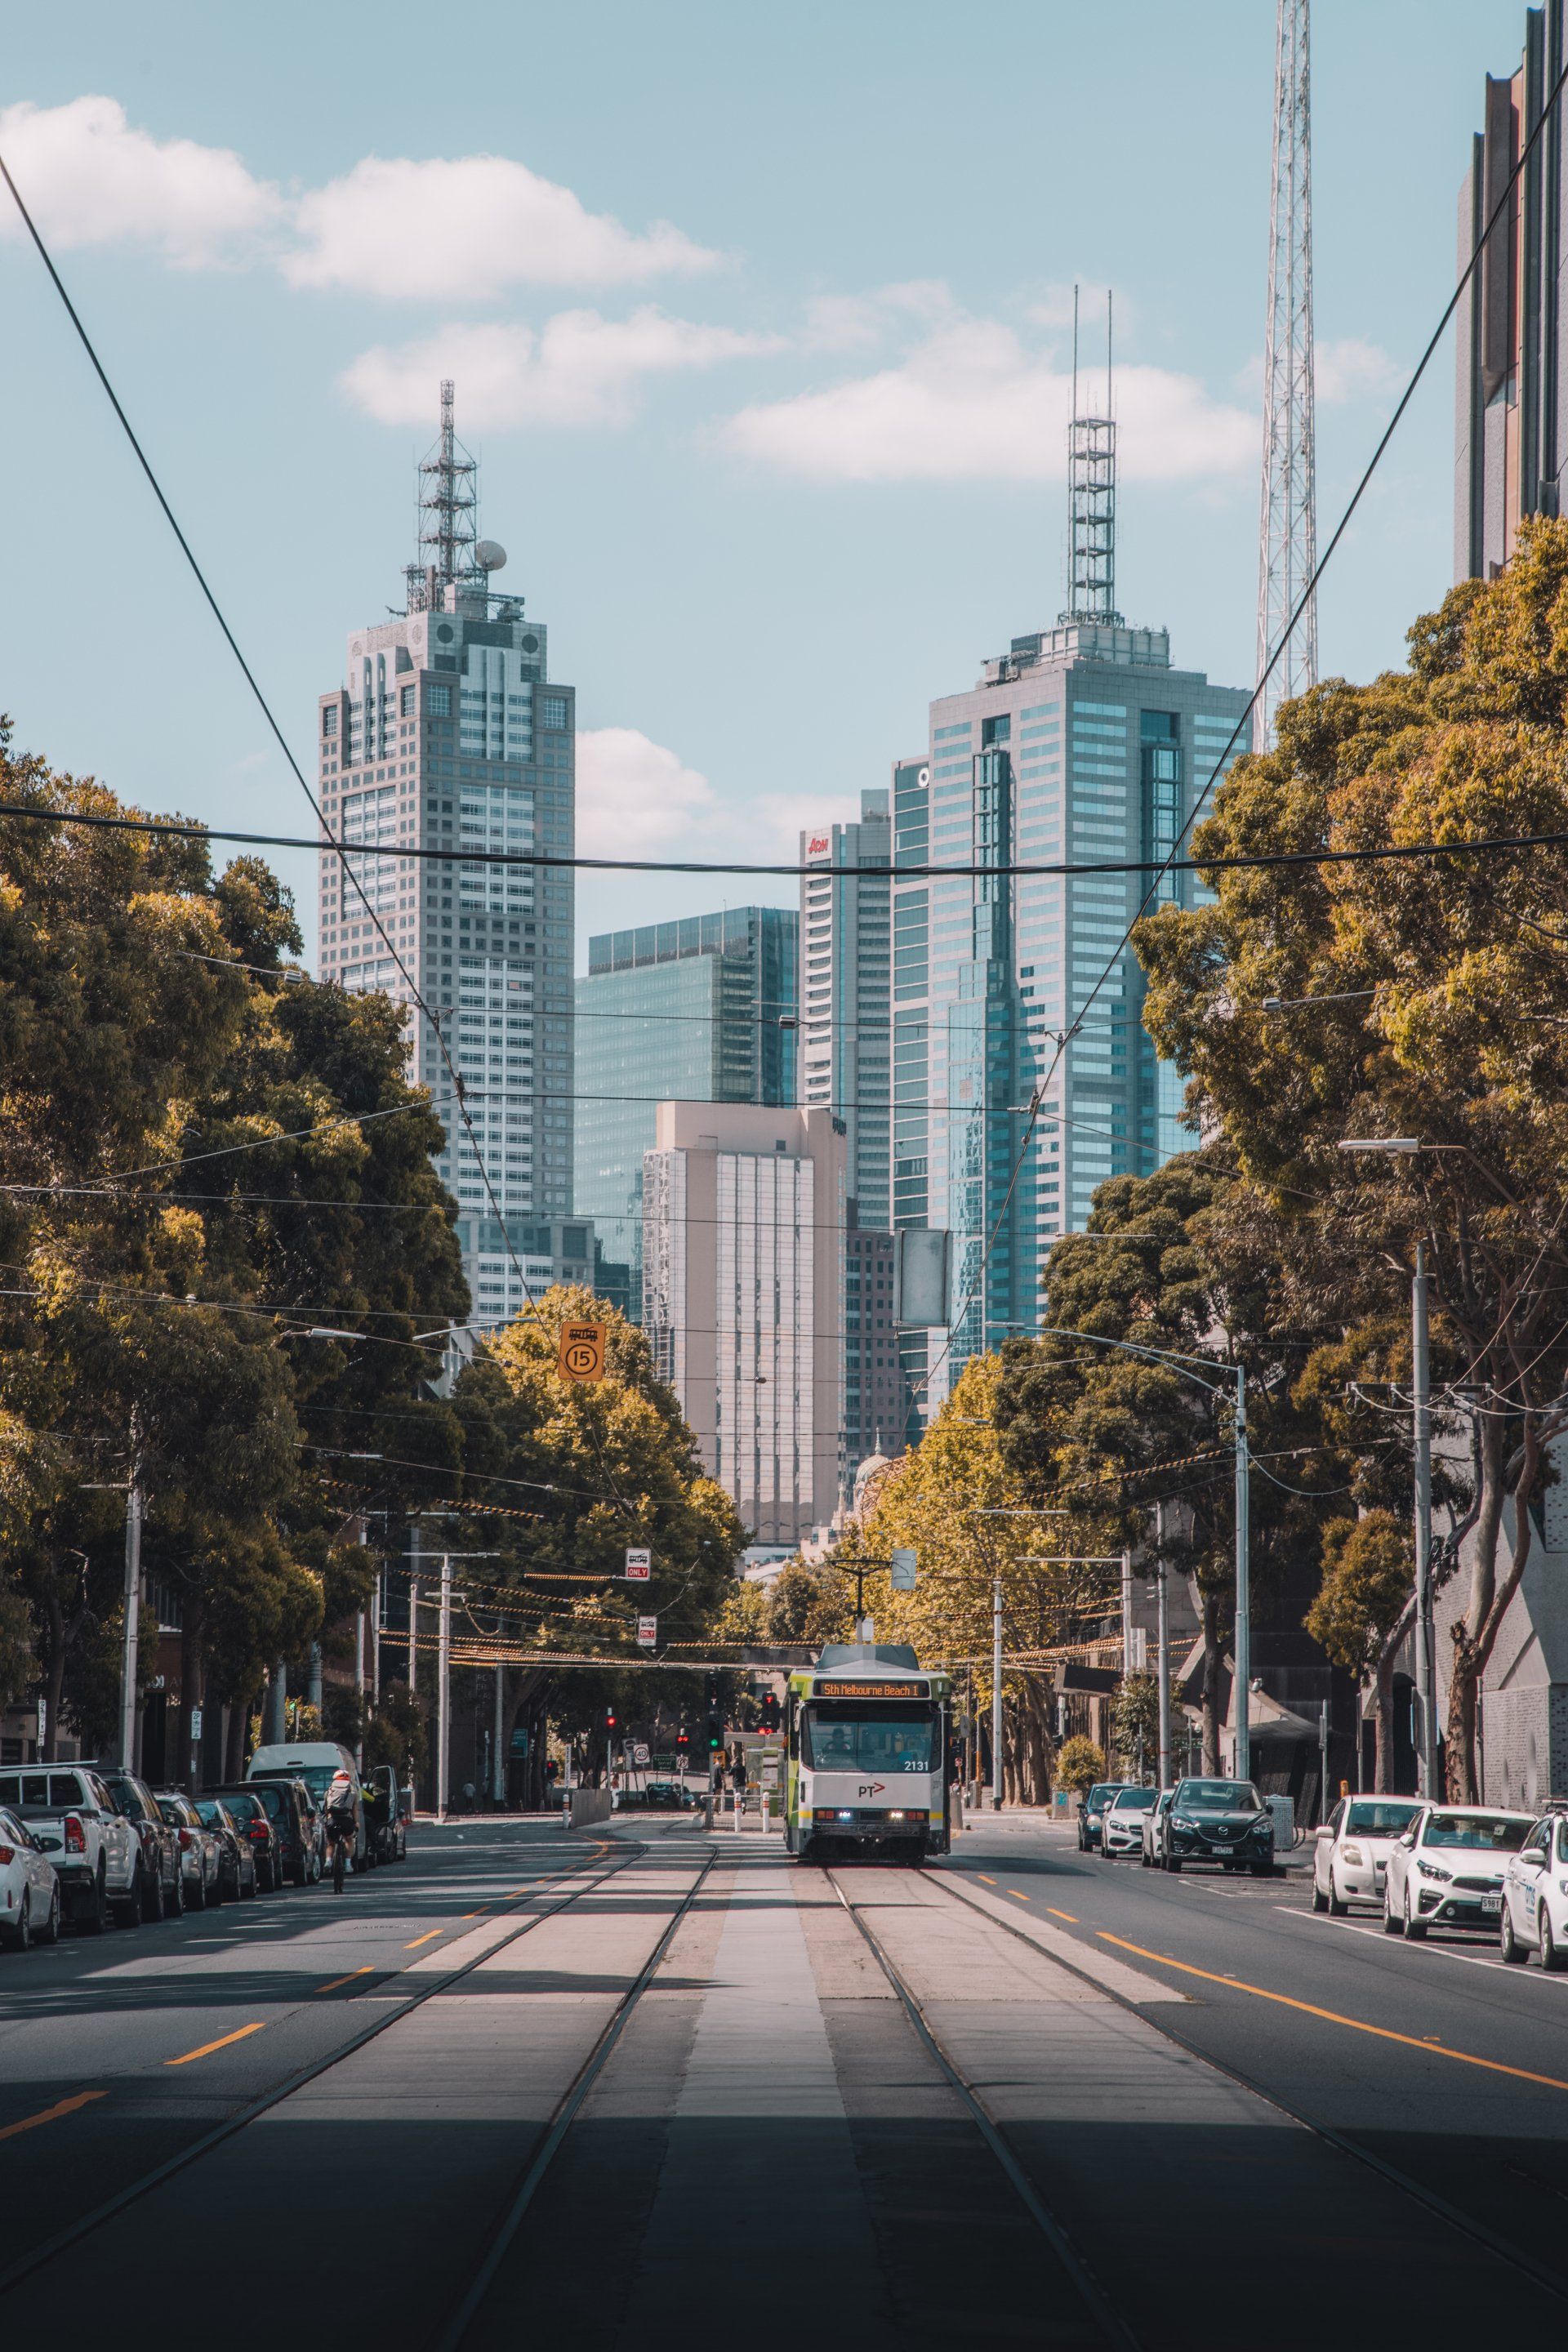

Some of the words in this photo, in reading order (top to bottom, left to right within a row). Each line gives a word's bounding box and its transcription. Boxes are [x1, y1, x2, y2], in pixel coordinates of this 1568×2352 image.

[572, 1350, 590, 1367] 15
[628, 1568, 648, 1577] ONLY
[824, 1684, 840, 1695] Sth
[841, 1684, 883, 1696] Melbourne
[884, 1685, 911, 1696] Beach
[912, 1685, 919, 1696] 1
[904, 1761, 929, 1771] 2131
[1482, 1899, 1499, 1909] S981
